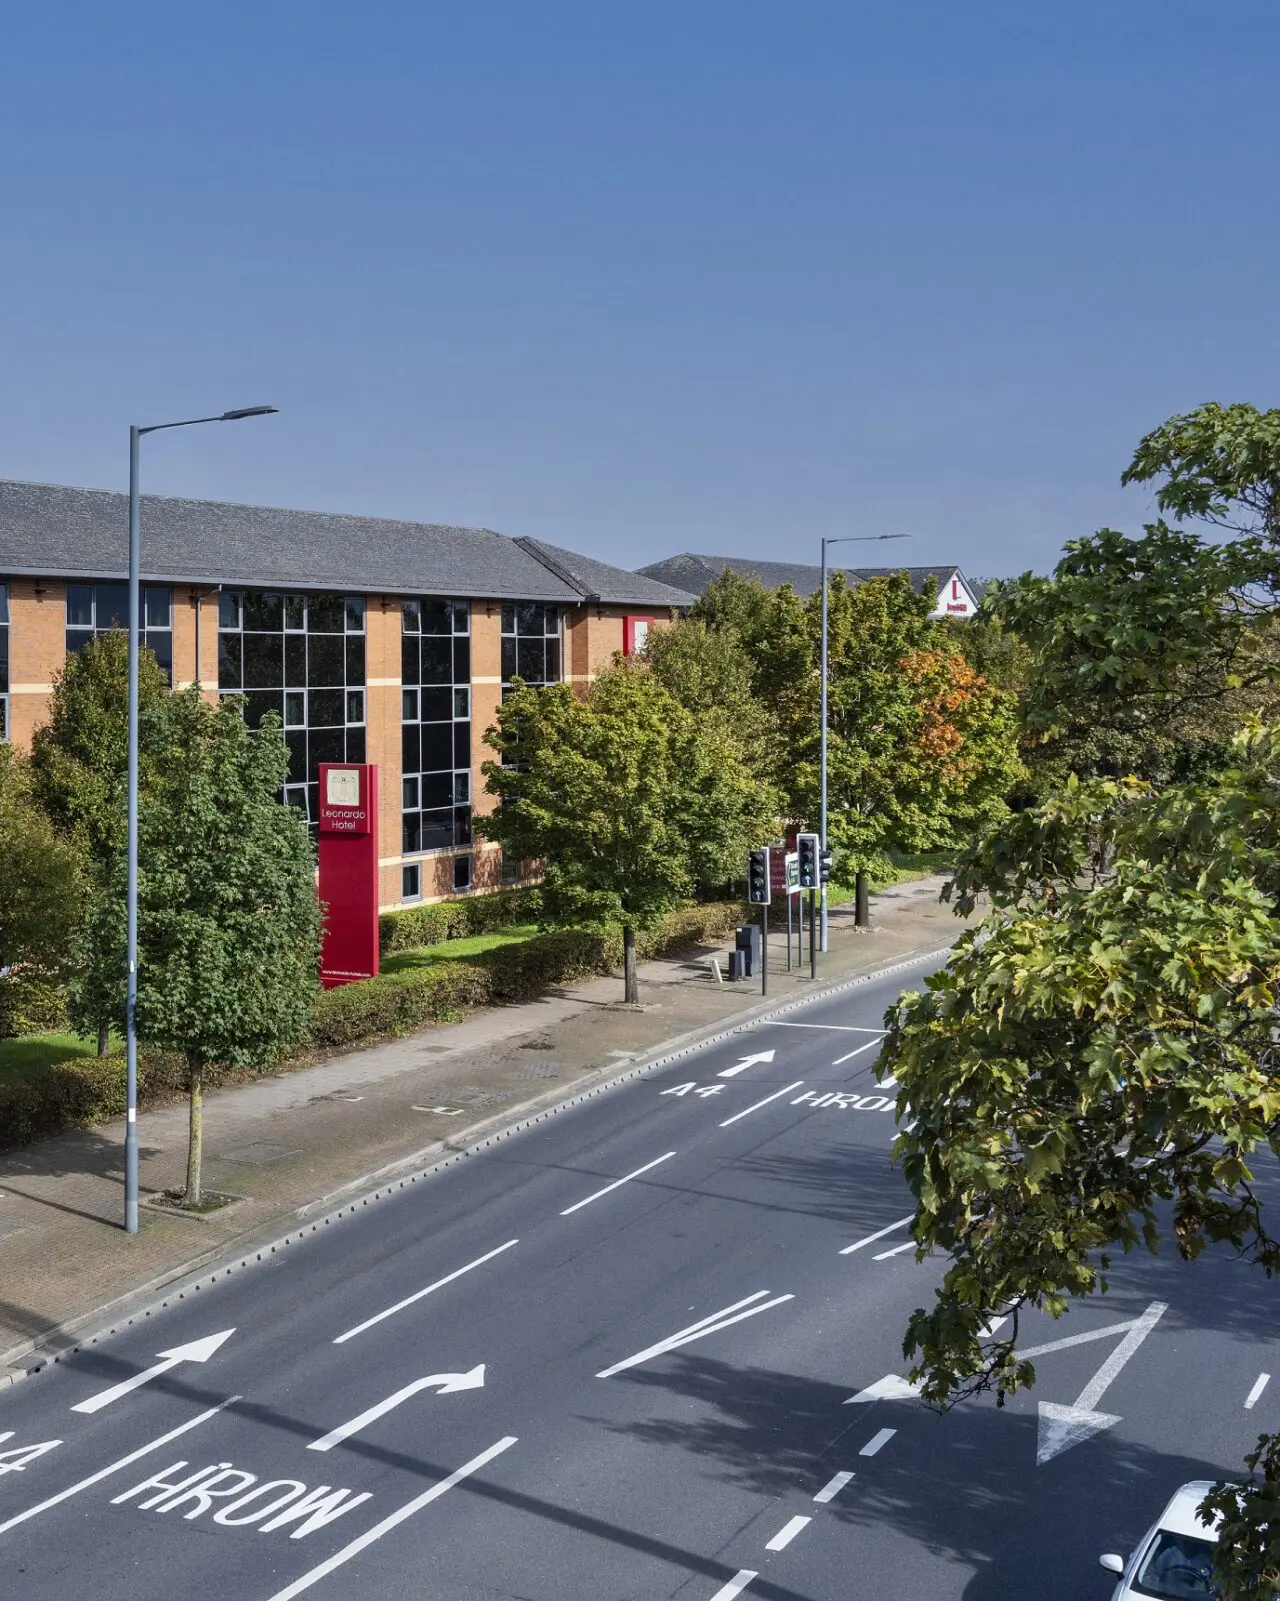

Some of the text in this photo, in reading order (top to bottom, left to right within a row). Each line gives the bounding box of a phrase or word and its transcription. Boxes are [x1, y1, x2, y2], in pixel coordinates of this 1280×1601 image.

[321, 809, 365, 819] Leonardo
[332, 820, 356, 830] Hotel
[659, 1082, 727, 1098] A4
